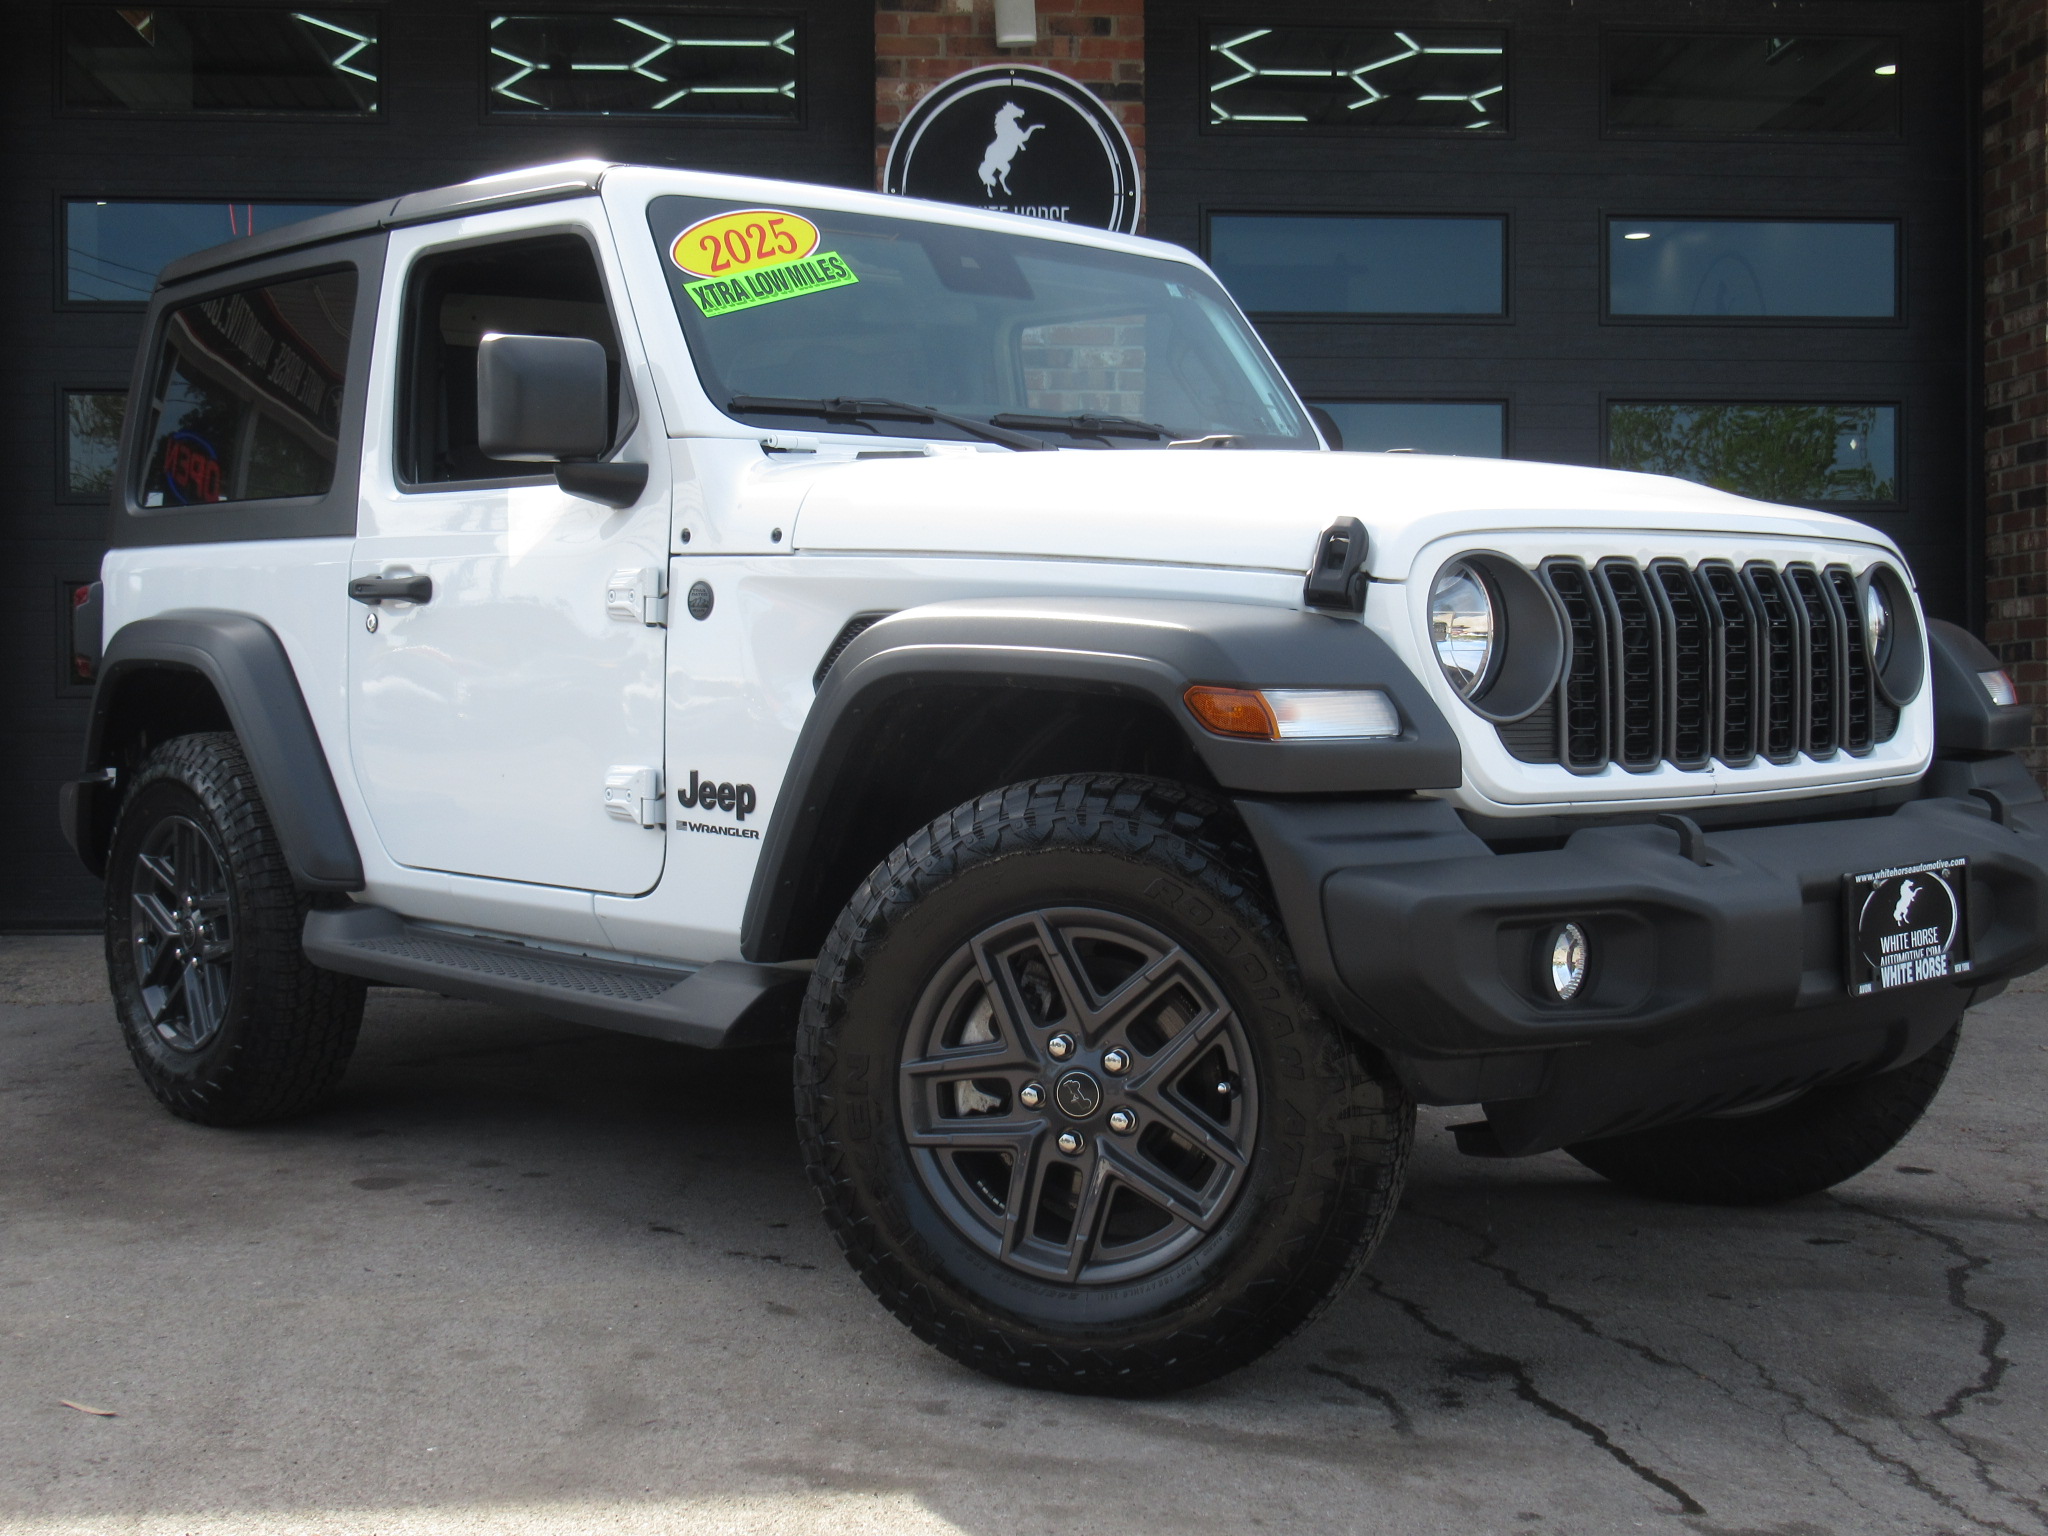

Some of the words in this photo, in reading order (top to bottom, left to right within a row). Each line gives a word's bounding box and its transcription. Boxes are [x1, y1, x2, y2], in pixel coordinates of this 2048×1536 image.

[700, 218, 798, 272] 2025
[693, 278, 750, 312] XTRA
[747, 267, 790, 299] LOW
[785, 256, 852, 289] MILES
[677, 769, 756, 821] Jeep
[688, 821, 760, 840] WRANGLER
[1855, 857, 1965, 883] www.whitehorseautomotive.com
[1880, 932, 1909, 954] WHITE
[1910, 926, 1939, 947] HORSE
[1880, 961, 1914, 988] WHITE
[1915, 954, 1948, 981] HORSE
